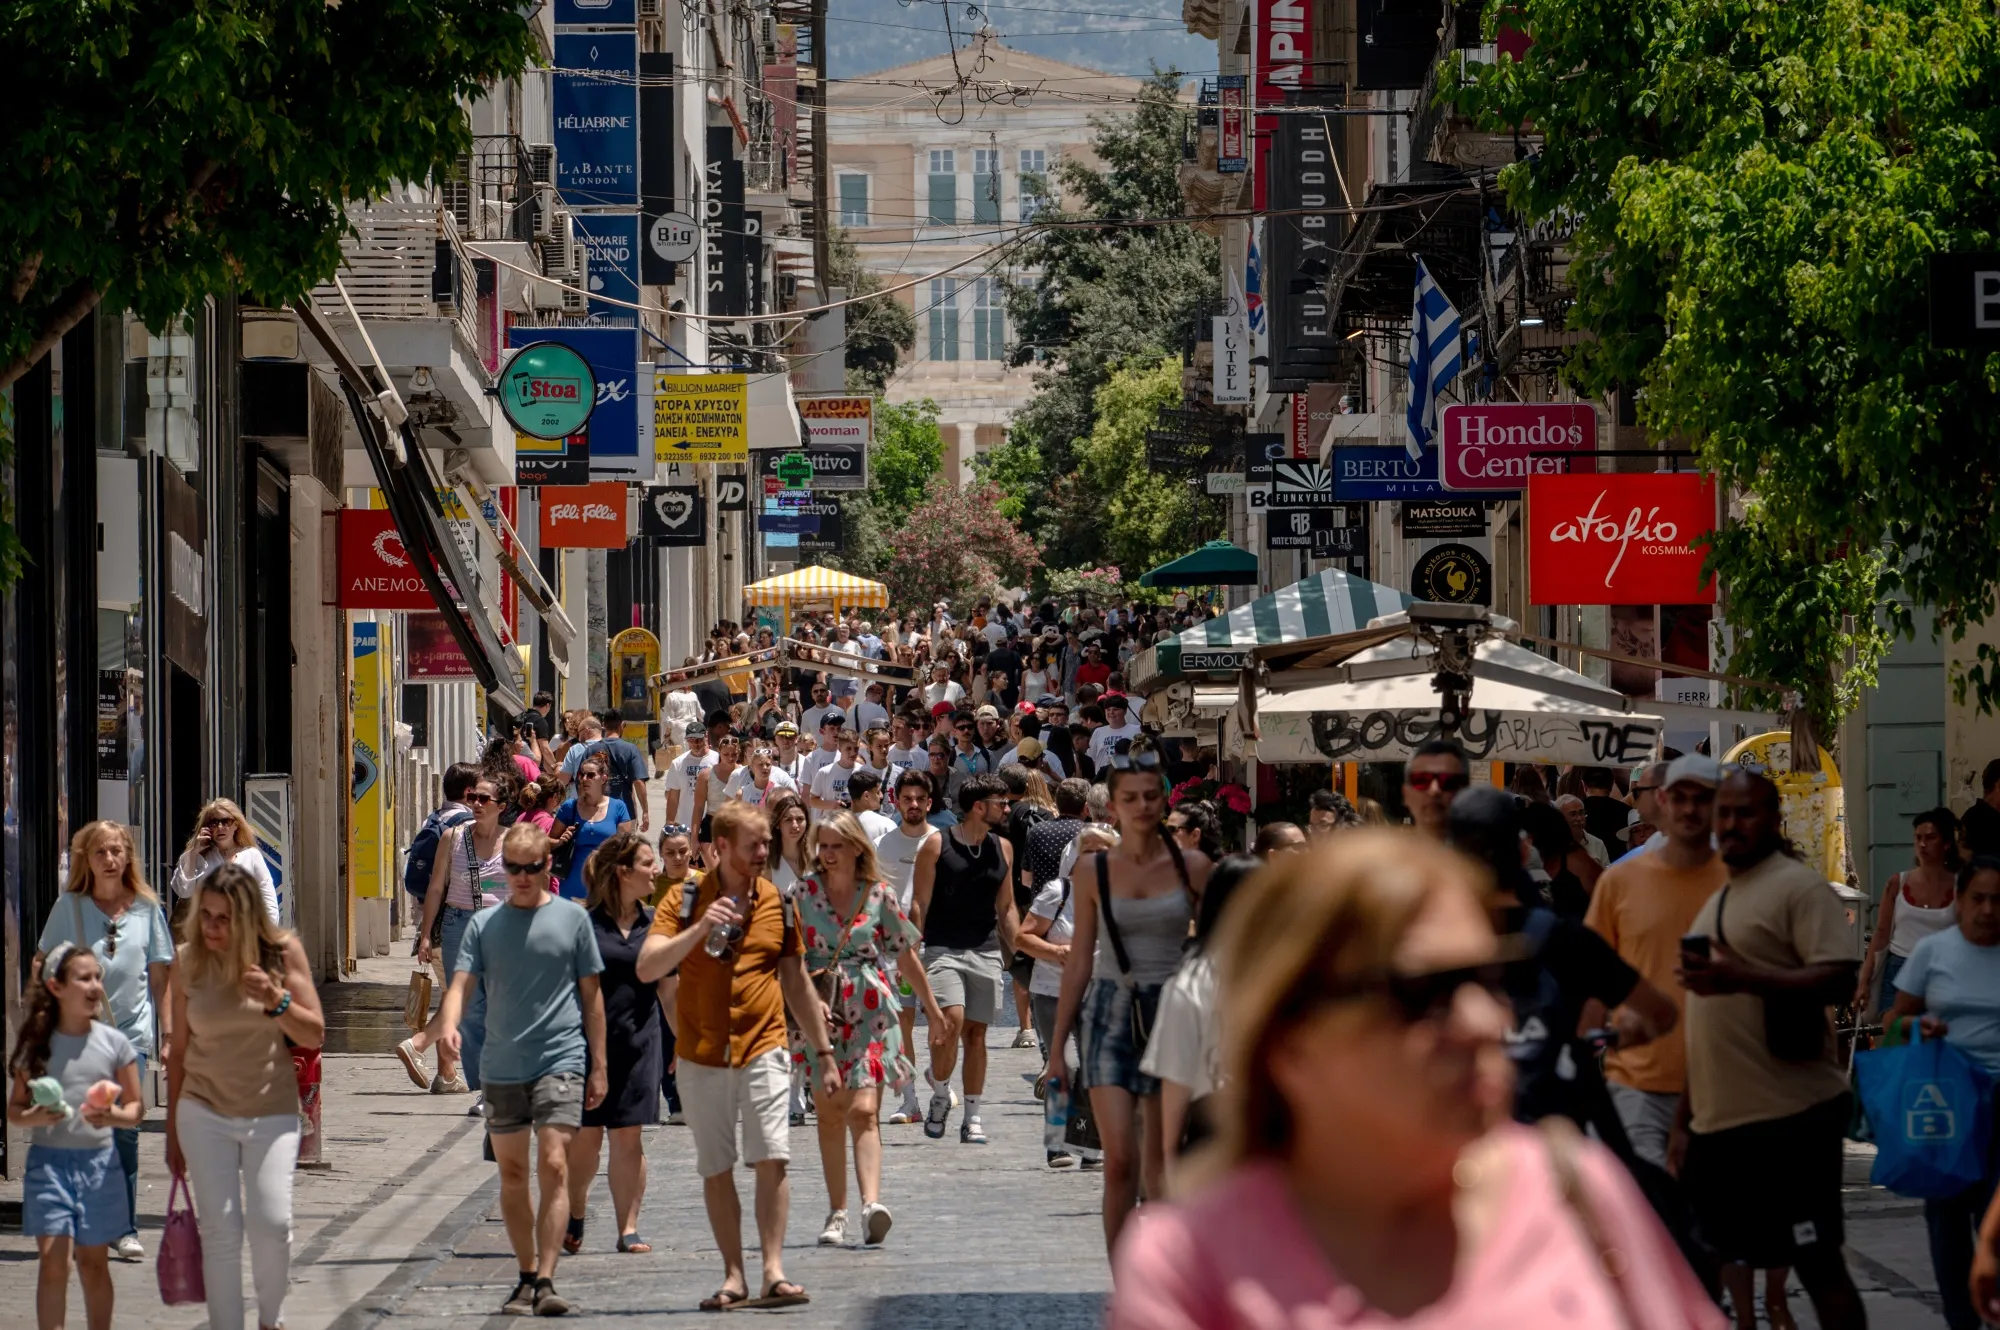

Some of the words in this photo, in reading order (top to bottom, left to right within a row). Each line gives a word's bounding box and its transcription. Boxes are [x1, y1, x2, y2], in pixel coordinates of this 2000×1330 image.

[1269, 0, 1304, 91] APIN
[558, 113, 631, 129] HÉLIABRINE
[571, 177, 618, 185] LONDON
[706, 160, 724, 292] SEPHORA
[1301, 115, 1327, 337] FUYBUDDH
[573, 235, 628, 246] NNEMARIE
[1974, 271, 2000, 329] B
[522, 380, 577, 399] iStoa
[667, 383, 703, 393] BILLION
[705, 383, 742, 393] MARKET
[694, 399, 740, 411] ΧΡΥΣΟΥ
[806, 400, 862, 412] ΑΓΟΡΑ
[1298, 393, 1307, 420] HOU
[655, 412, 683, 425] ΩΛΗΣΗ
[686, 412, 742, 424] ΚΟΣΜΗΜΑΤΩΝ
[1311, 411, 1333, 420] ecc
[696, 426, 739, 438] ΕΝΕΧΥΡΑ
[809, 426, 860, 436] woman
[1457, 415, 1583, 446] Hondos
[664, 453, 693, 461] 3223555
[734, 452, 746, 460] 100
[1458, 446, 1567, 478] Center
[519, 470, 548, 481] bags
[778, 490, 811, 498] PHARMACY
[1386, 484, 1445, 492] MILA
[550, 504, 579, 527] Folli
[582, 504, 617, 523] Follie
[1410, 506, 1477, 519] MATSOUKA
[1424, 550, 1456, 576] mykonos
[1461, 552, 1481, 574] charm
[351, 577, 430, 592] ΑΝΕΜΟΣ
[353, 637, 377, 647] EPAIR
[355, 738, 378, 760] TODAY
